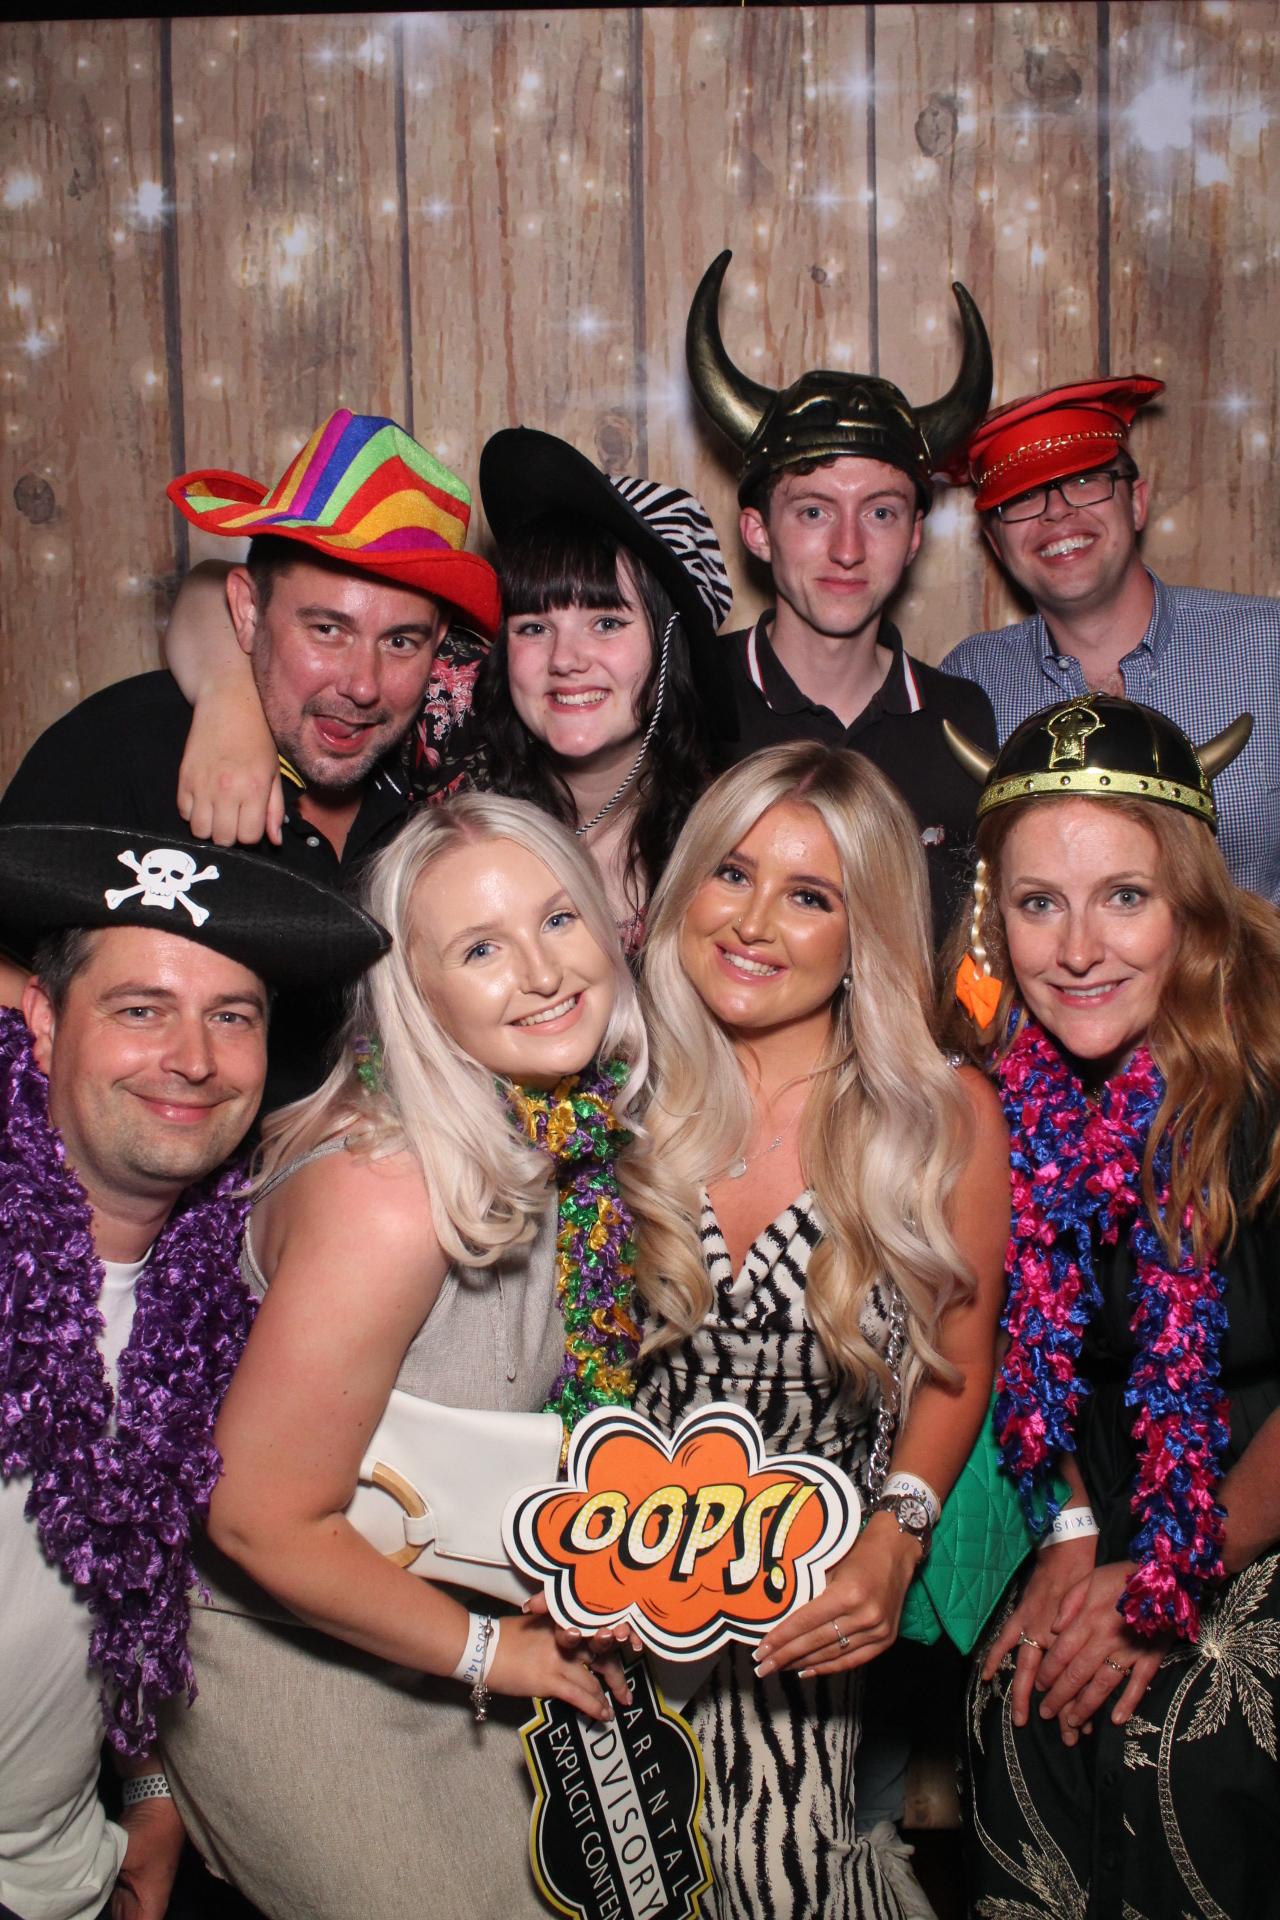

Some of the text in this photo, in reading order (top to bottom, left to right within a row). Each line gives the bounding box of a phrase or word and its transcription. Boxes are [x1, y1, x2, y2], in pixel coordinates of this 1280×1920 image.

[560, 1482, 821, 1602] OOPS!
[548, 1722, 596, 1829] EXPLICIT
[586, 1716, 664, 1916] DVISORY
